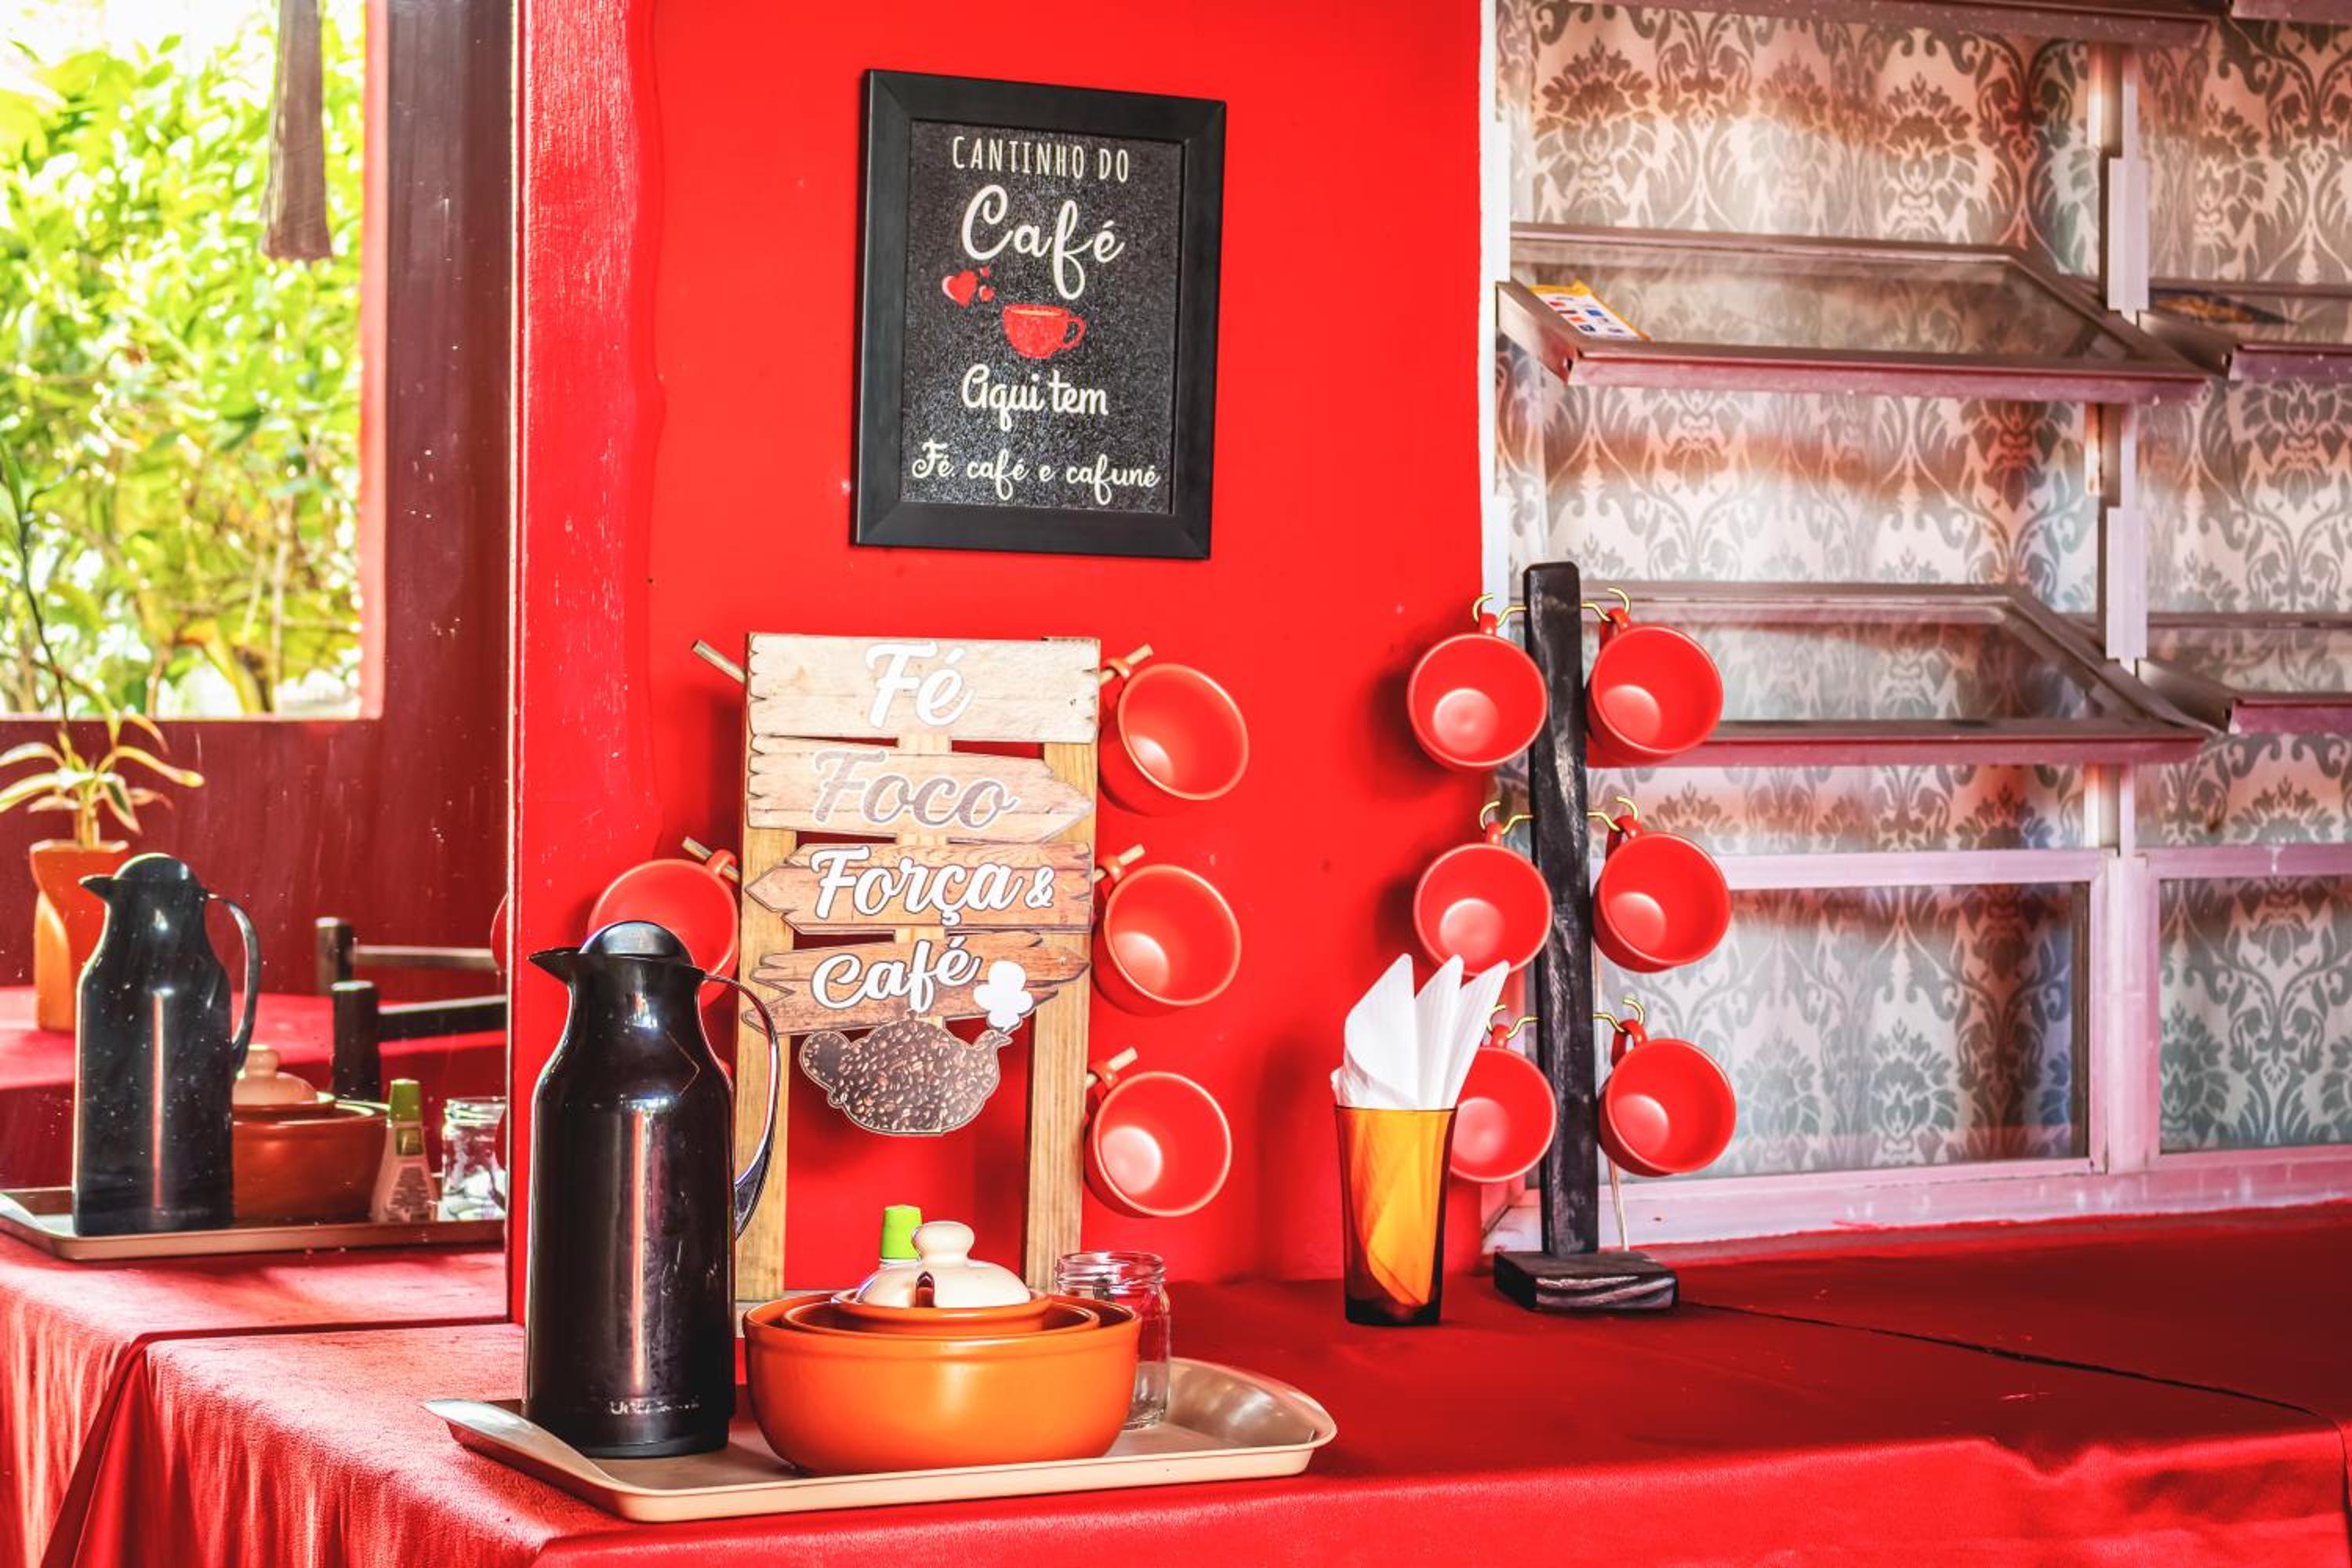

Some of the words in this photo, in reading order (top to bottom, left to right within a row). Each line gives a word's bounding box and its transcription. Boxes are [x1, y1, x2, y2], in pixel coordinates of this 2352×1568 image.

[952, 136, 1085, 180] CANTINHO
[1098, 147, 1130, 183] DO
[961, 184, 1126, 301] Café
[961, 363, 1044, 431] Aqui
[1049, 368, 1108, 416] tem
[967, 448, 1029, 501] café
[1039, 464, 1057, 483] e
[1065, 453, 1161, 506] cafuné
[866, 641, 975, 728] Fé
[811, 748, 1020, 830] Foco
[810, 846, 1025, 927] Força
[1025, 866, 1055, 909] &
[810, 935, 982, 1013] Café
